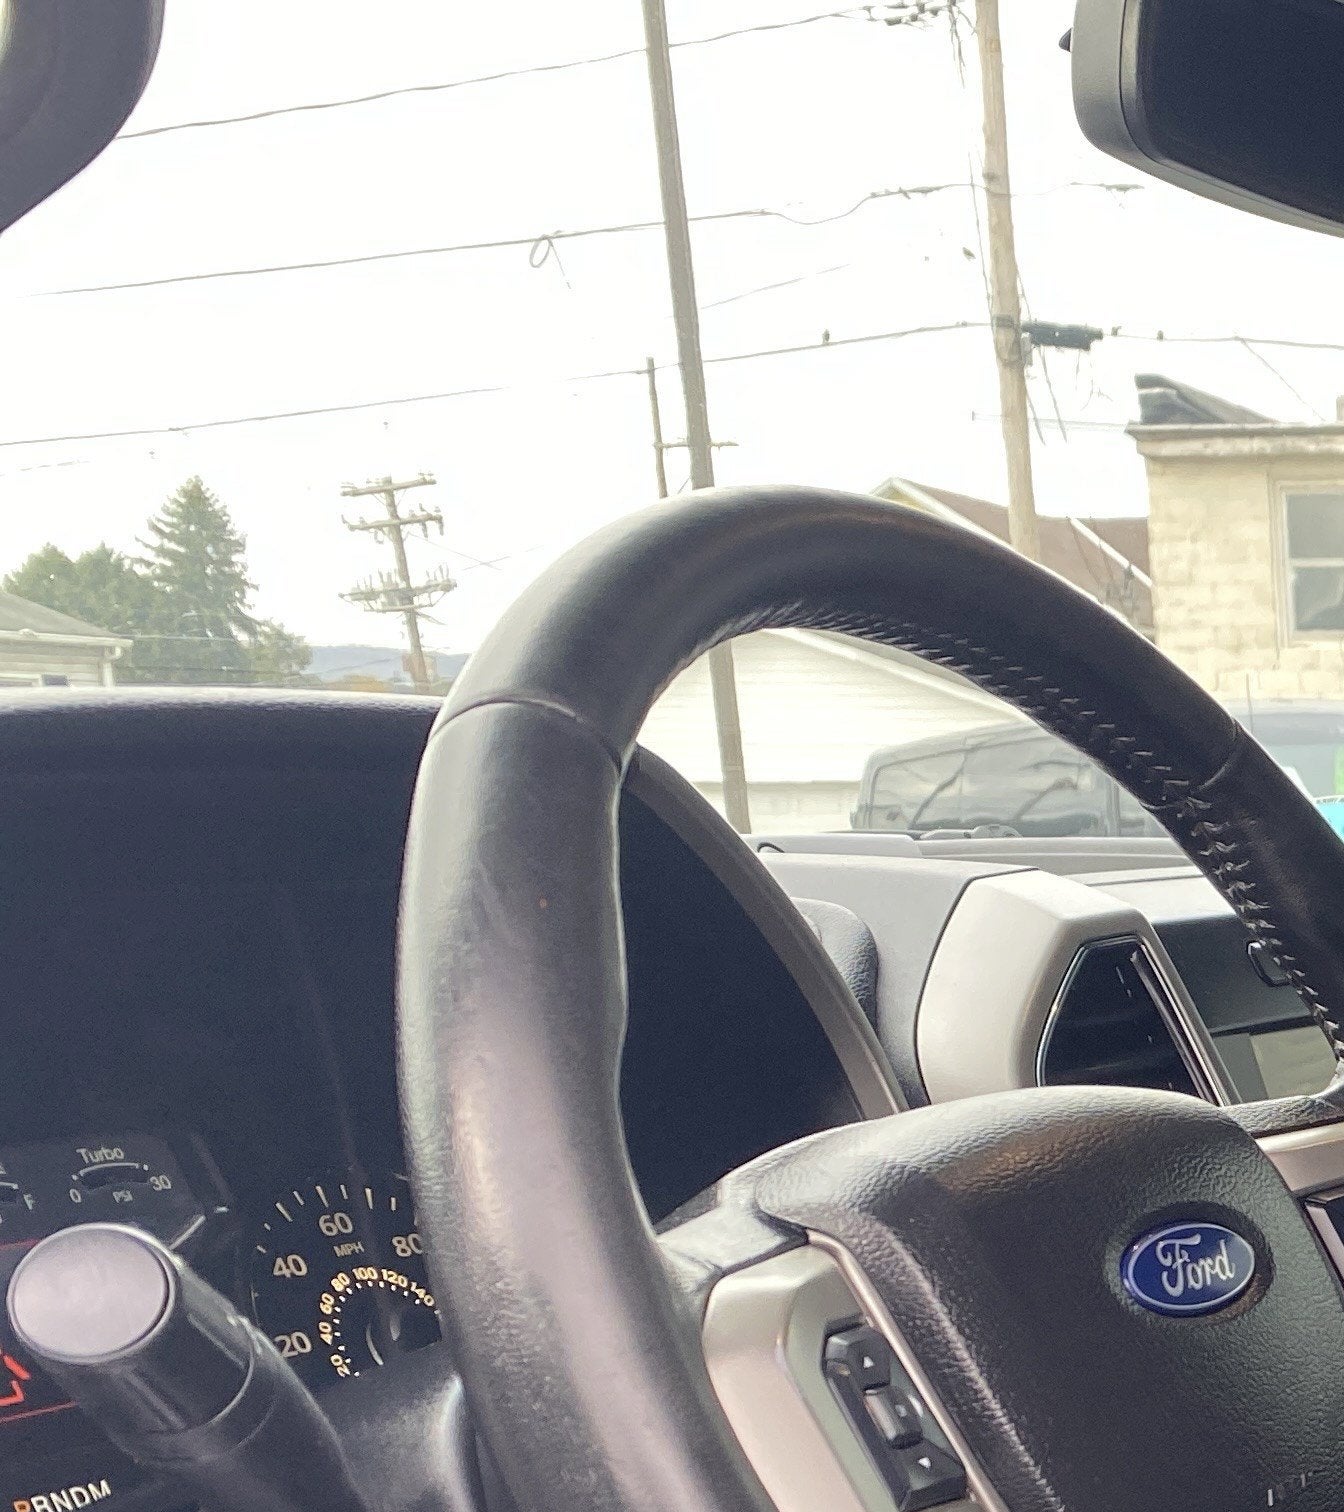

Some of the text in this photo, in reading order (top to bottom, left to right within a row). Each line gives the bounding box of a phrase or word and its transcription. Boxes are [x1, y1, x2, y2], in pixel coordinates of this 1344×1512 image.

[76, 1147, 125, 1164] Turbo
[149, 1174, 172, 1191] 30
[69, 1187, 82, 1203] 0
[318, 1212, 353, 1237] 60
[333, 1241, 365, 1257] MPH
[391, 1233, 424, 1257] 80
[273, 1254, 308, 1278] 40
[352, 1266, 379, 1281] 100
[1155, 1233, 1236, 1297] Ford
[330, 1272, 350, 1292] 80
[381, 1268, 408, 1288] 120
[319, 1292, 335, 1315] 60
[410, 1281, 435, 1307] 140
[273, 1331, 312, 1358] 20
[318, 1321, 333, 1345] 40
[330, 1353, 350, 1378] 20
